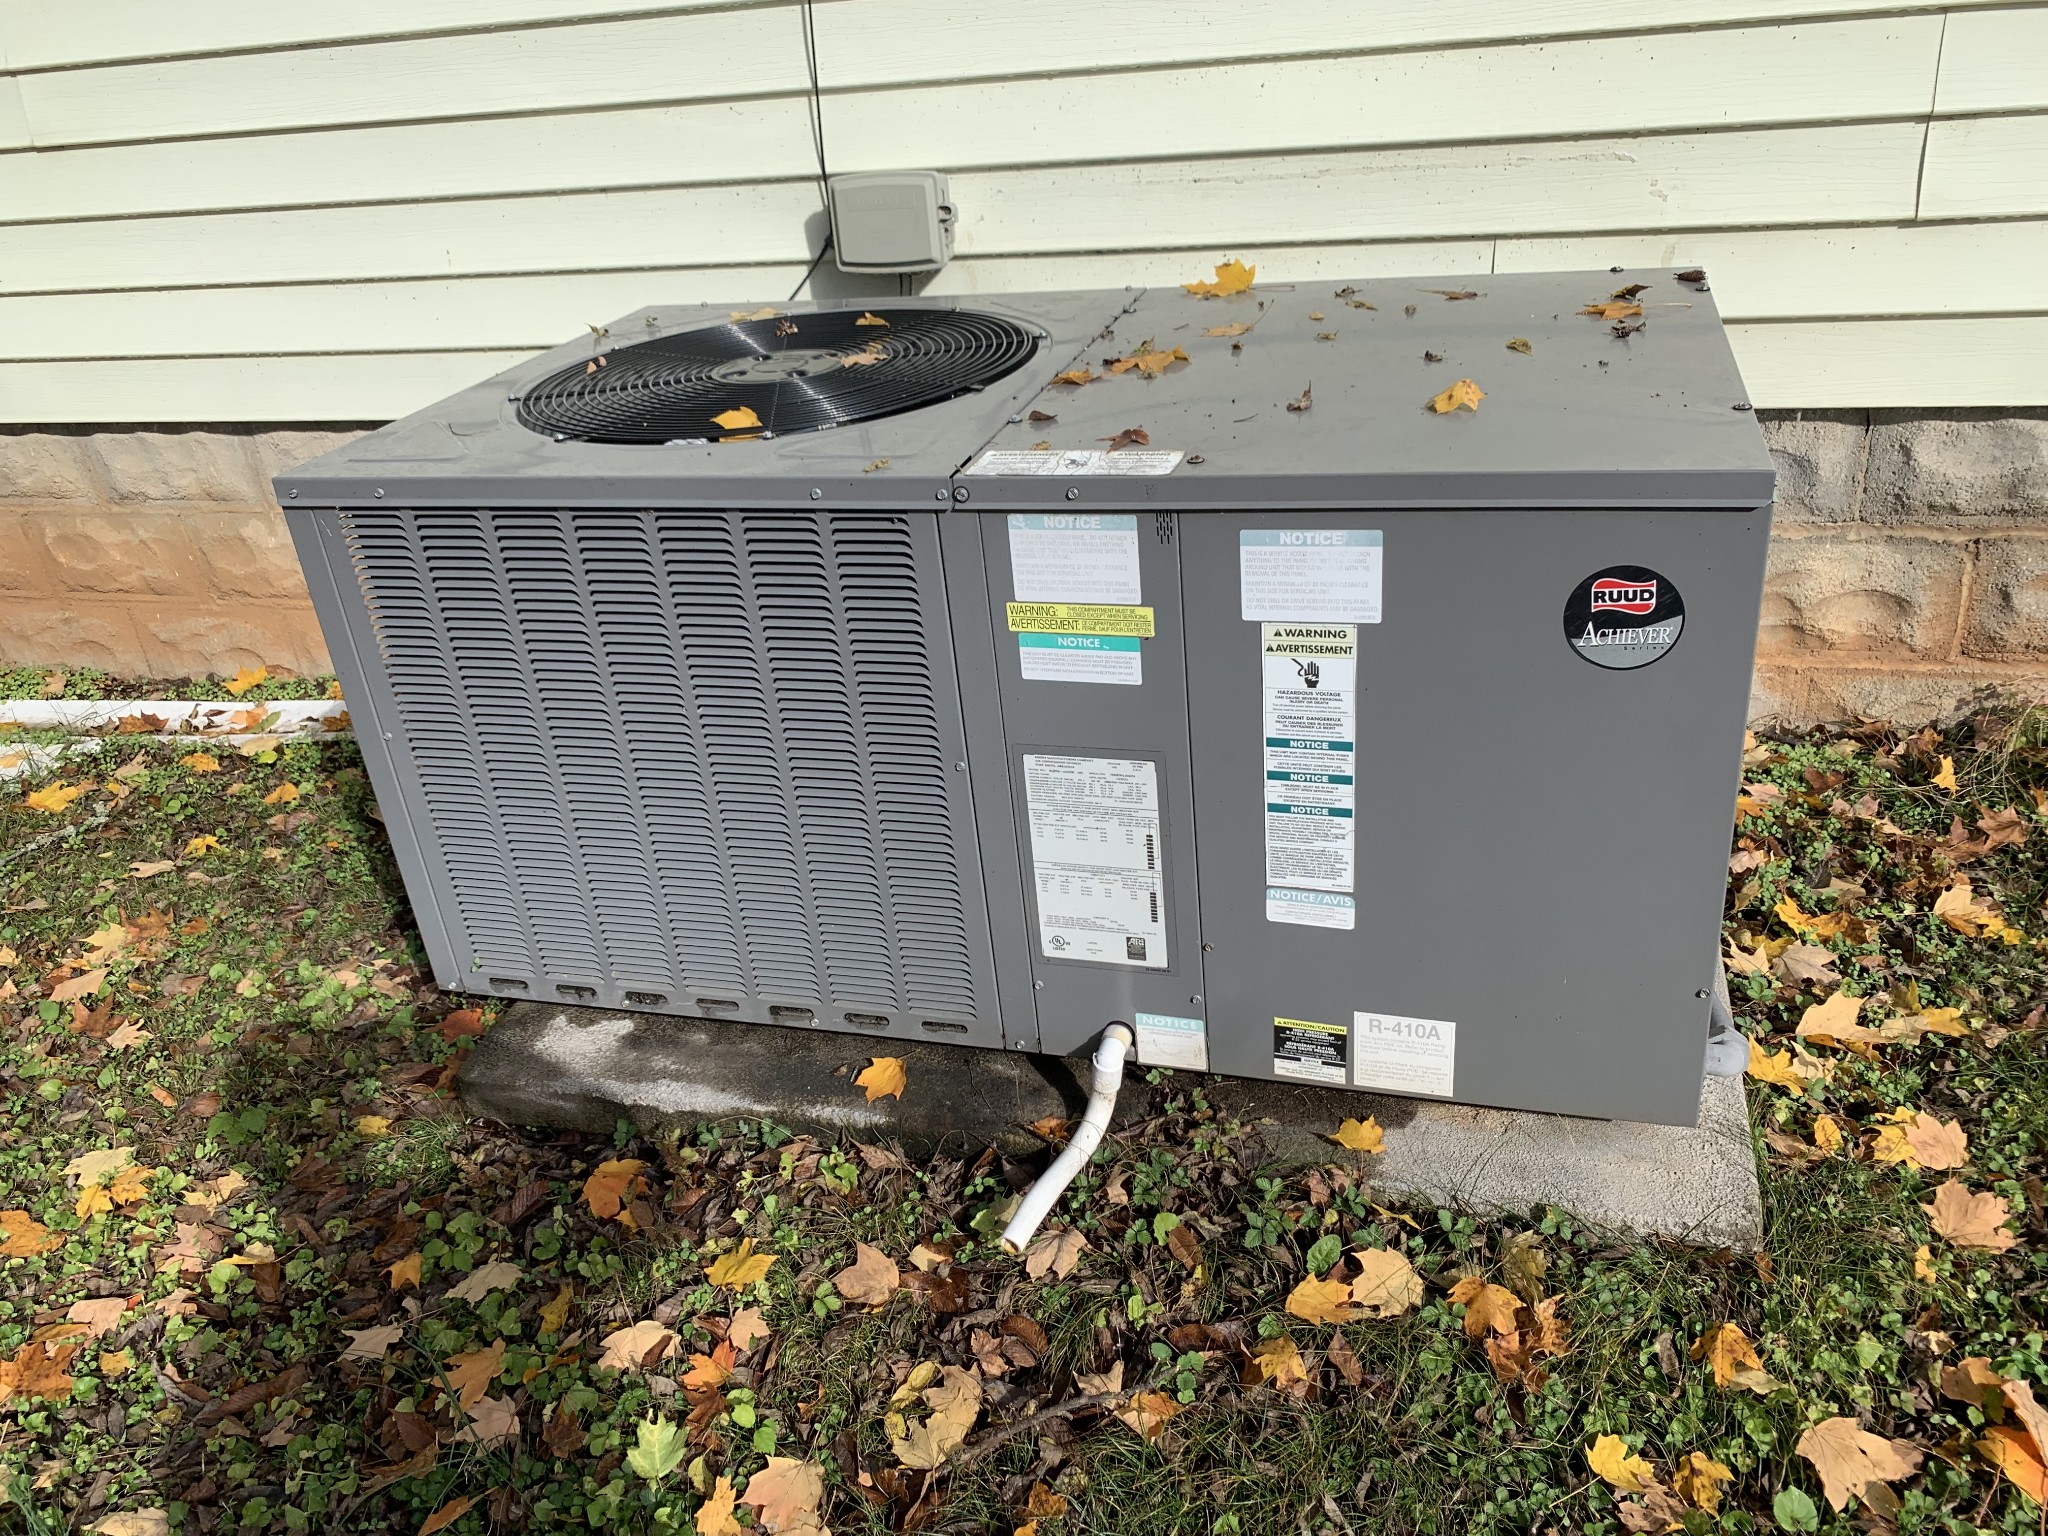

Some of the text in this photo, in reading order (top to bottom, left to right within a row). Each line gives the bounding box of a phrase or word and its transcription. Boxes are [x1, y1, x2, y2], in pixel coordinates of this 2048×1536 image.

[1044, 516, 1101, 528] NOTICE
[1280, 532, 1343, 545] NOTICE
[1593, 589, 1654, 603] RUUD
[1009, 605, 1058, 616] WARNING:
[1011, 619, 1080, 630] AVERTISSEMENT:
[1284, 628, 1347, 639] WARNING
[1058, 637, 1100, 648] NOTICE
[1276, 644, 1353, 654] AVERTISSEMENT
[1290, 740, 1329, 749] NOTICE
[1290, 774, 1329, 782] NOTICE
[1291, 806, 1329, 815] NOTICE
[1270, 890, 1351, 906] NOTICE/AVIS
[1143, 1016, 1197, 1029] NOTICE
[1283, 1021, 1344, 1033] ATTENTION/CAUTION
[1369, 1018, 1441, 1040] R-410A
